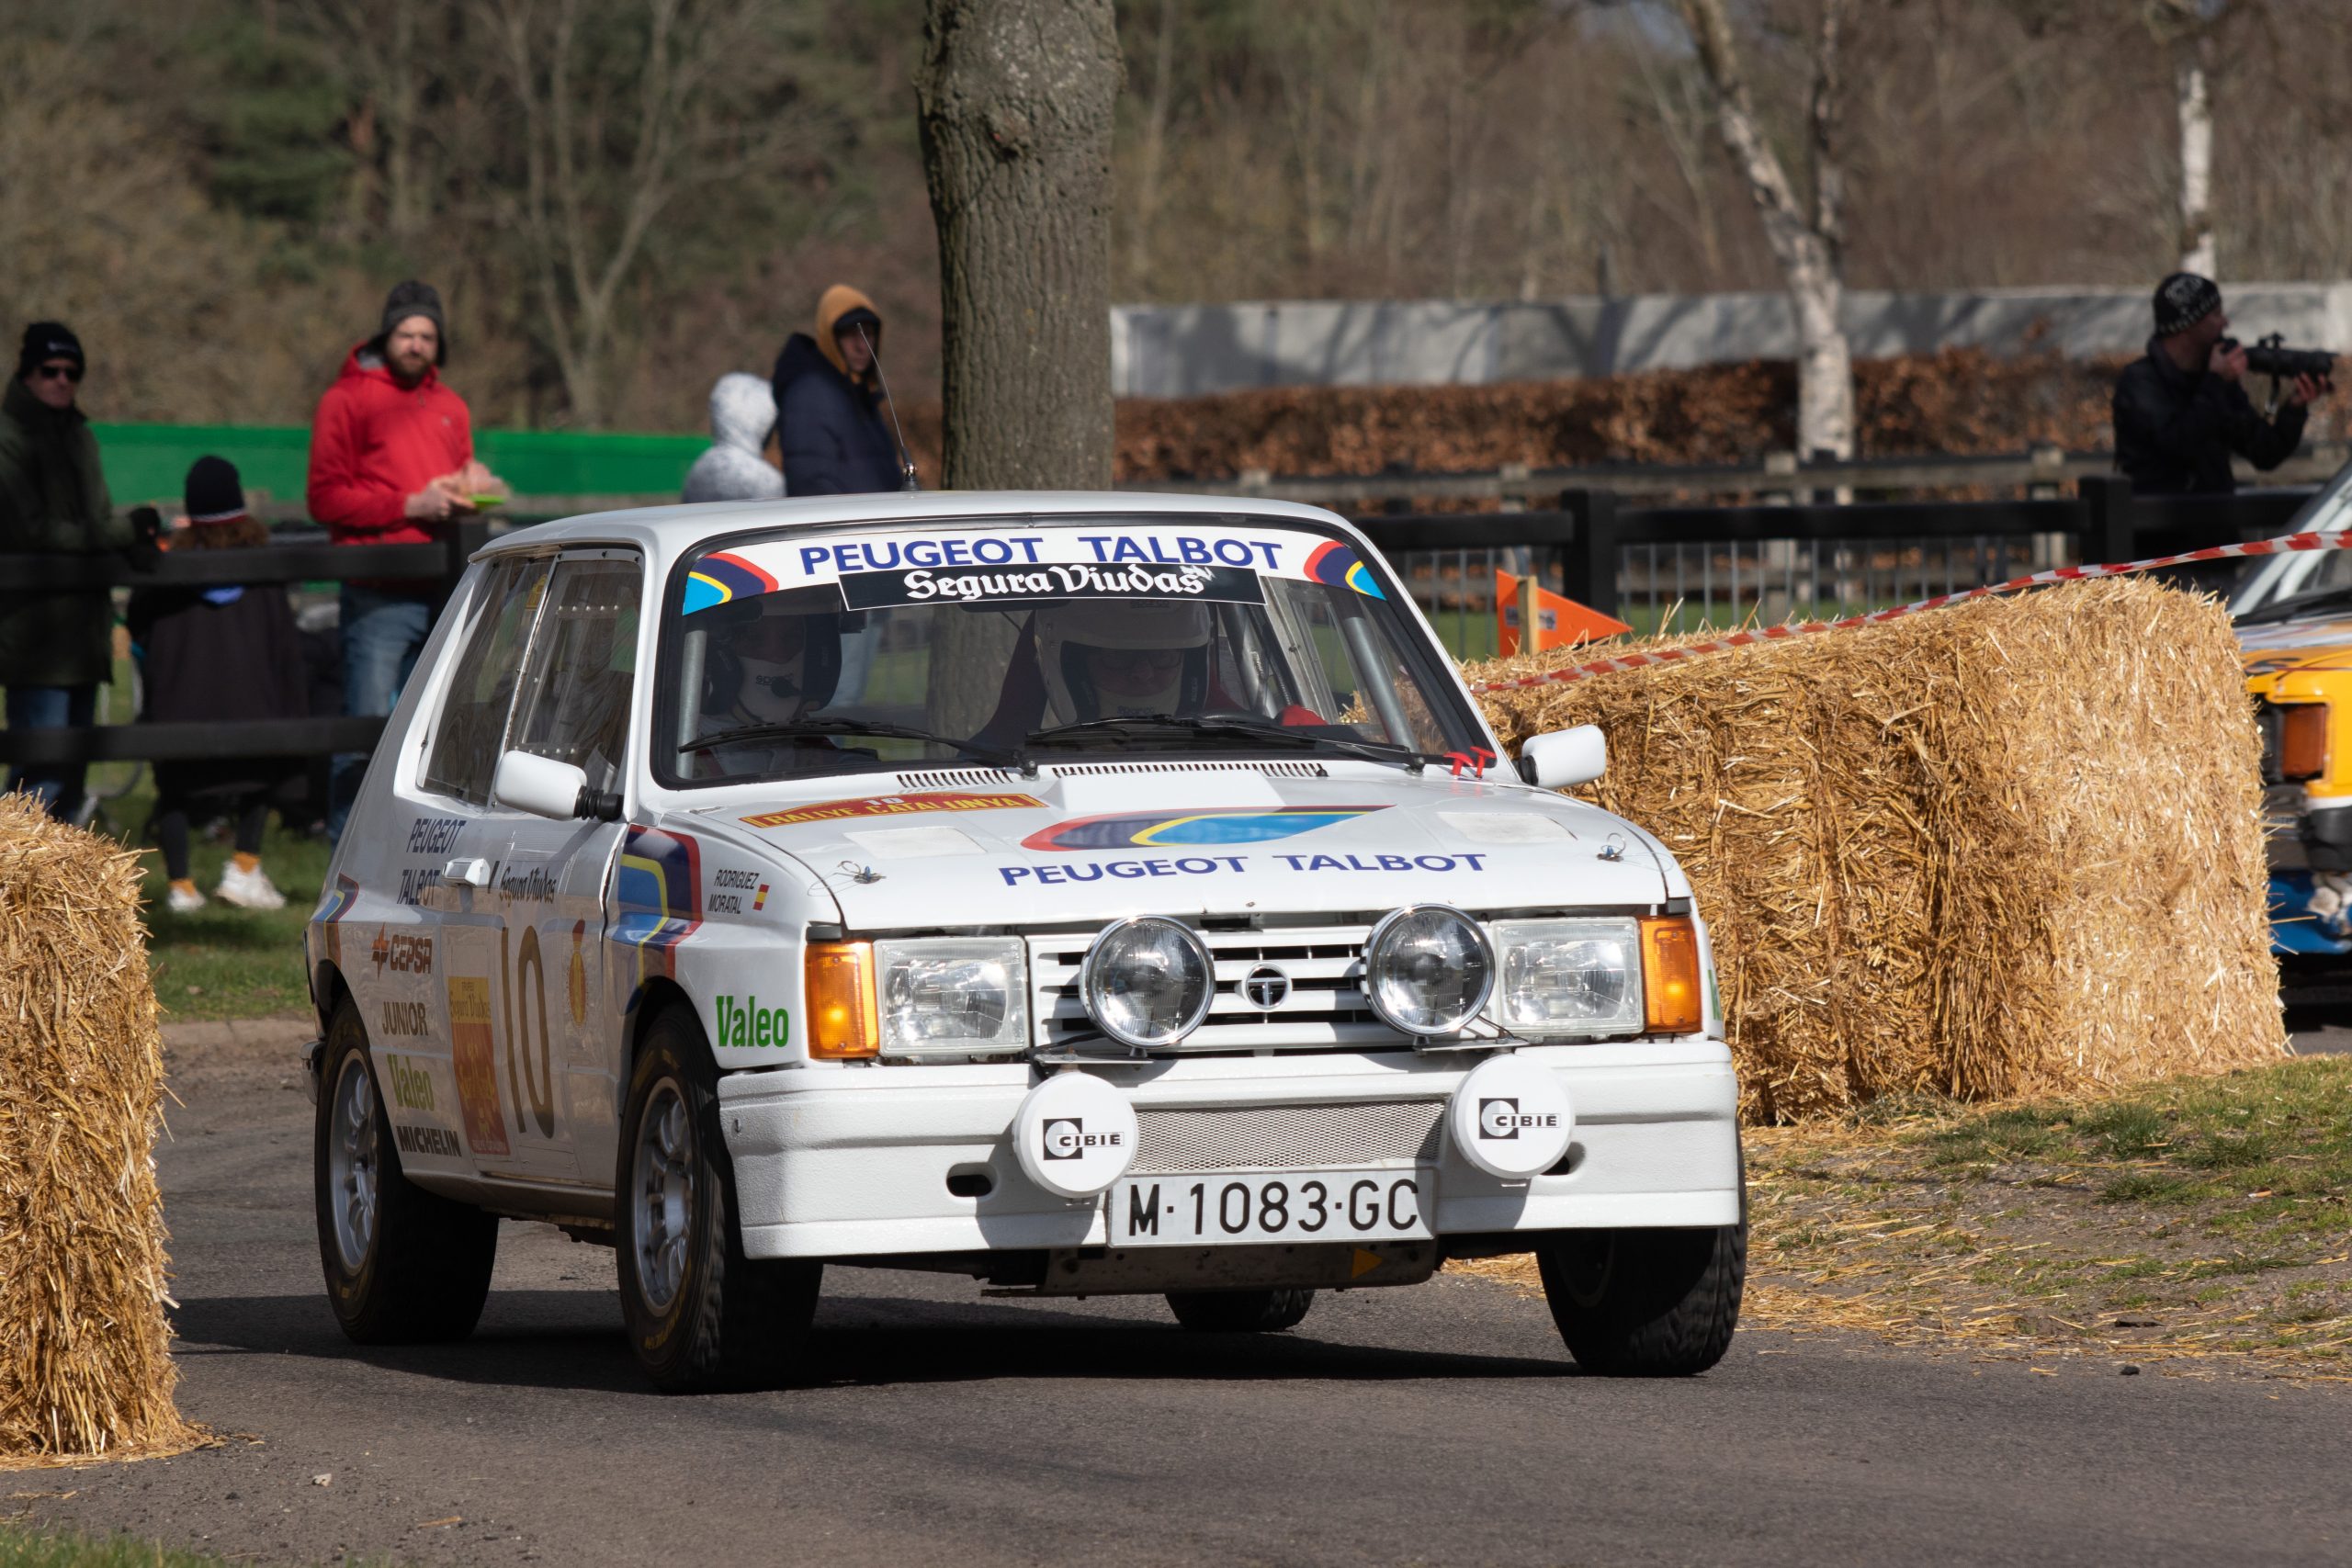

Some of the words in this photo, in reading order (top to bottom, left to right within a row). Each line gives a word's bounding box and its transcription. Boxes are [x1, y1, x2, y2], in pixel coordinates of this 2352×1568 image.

[799, 538, 1043, 575] PEUGEOT
[1080, 536, 1282, 570] TALBOT
[904, 566, 1052, 601] Segura
[1054, 563, 1204, 594] Viudas
[763, 807, 862, 826] RALLYE
[867, 797, 1025, 815] CATALUNYA
[406, 818, 467, 854] PEUGEOT
[397, 869, 440, 906] TALBOT
[714, 869, 760, 890] RODRIGUEZ
[998, 856, 1249, 886] PEUGEOT
[1272, 853, 1487, 872] TALBOT
[707, 894, 742, 915] MORATAL
[390, 934, 433, 975] CEPSA
[382, 1001, 429, 1036] JUNIOR
[502, 925, 555, 1139] 10
[716, 995, 789, 1047] Valeo
[387, 1054, 435, 1111] Valeo
[396, 1125, 462, 1157] MICHELIN
